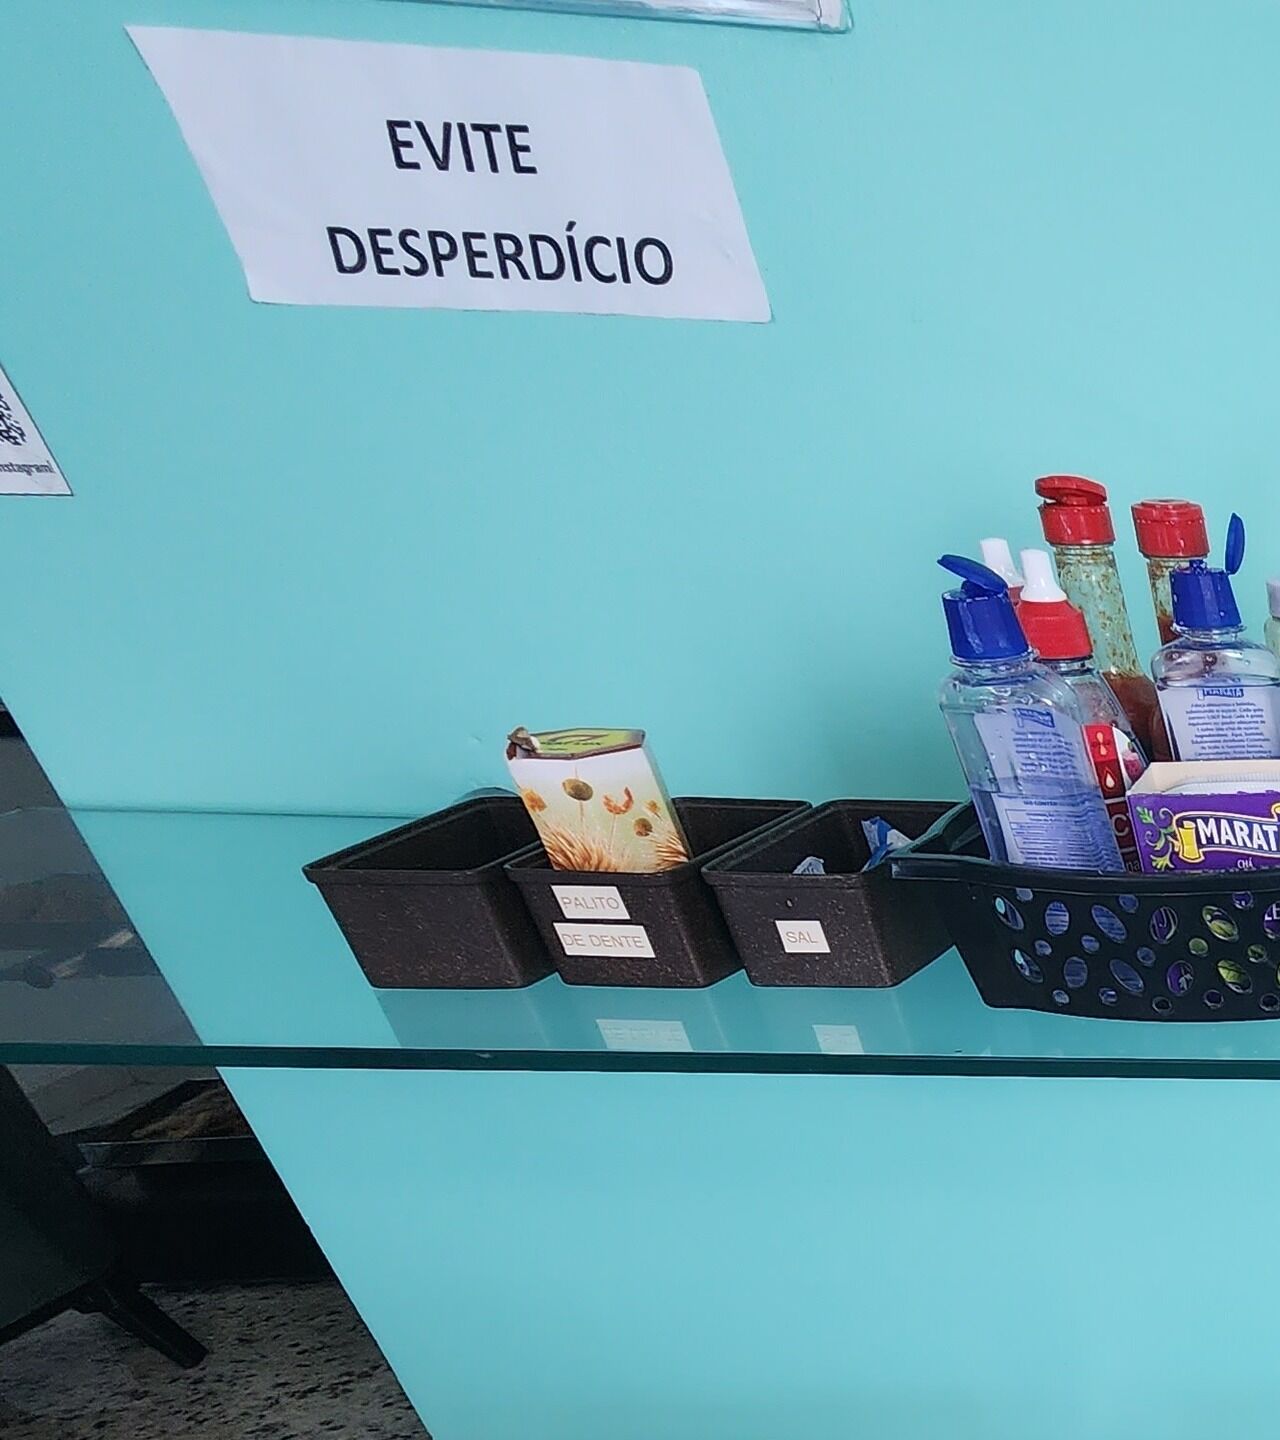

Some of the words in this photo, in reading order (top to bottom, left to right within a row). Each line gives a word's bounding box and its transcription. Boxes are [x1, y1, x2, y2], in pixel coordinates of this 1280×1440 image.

[386, 119, 538, 174] EVITE
[326, 221, 674, 285] DESPERDÍCIO
[1237, 857, 1253, 869] CHÁ
[561, 896, 620, 910] PALITO
[561, 933, 586, 946] DE
[588, 934, 645, 948] DENTE
[786, 931, 819, 943] SAL
